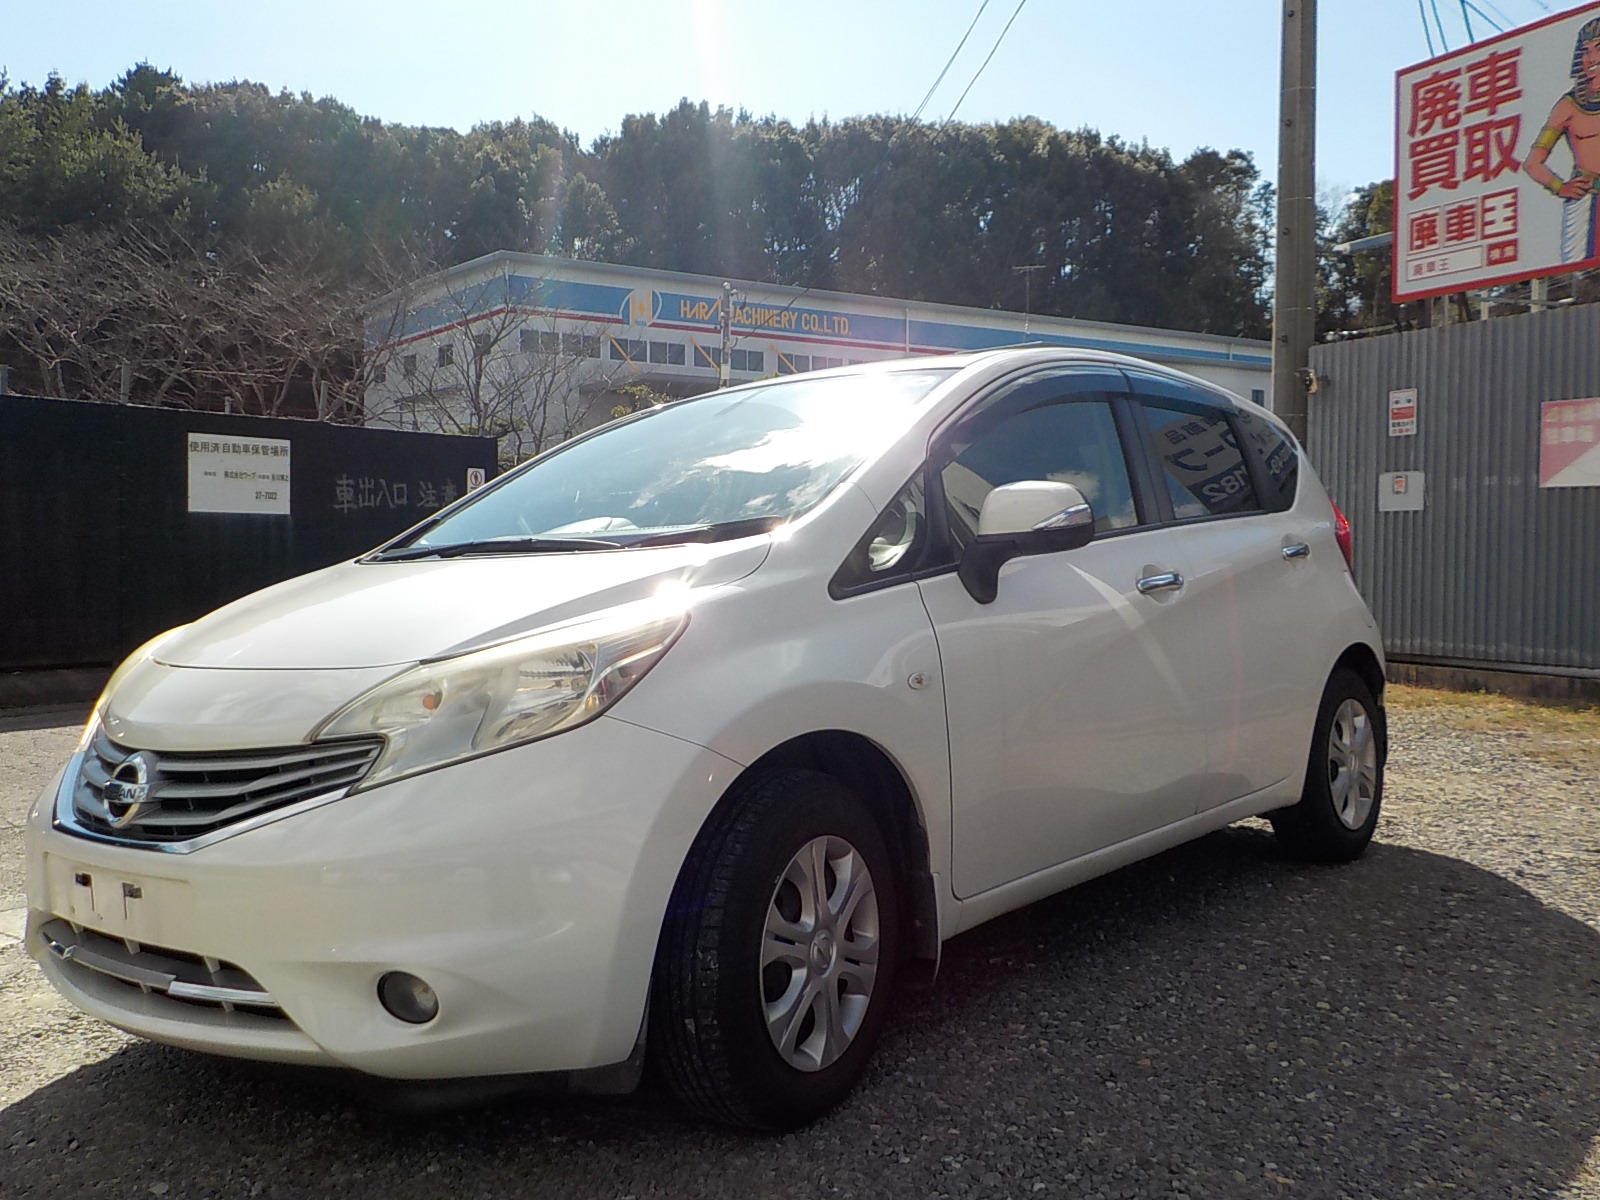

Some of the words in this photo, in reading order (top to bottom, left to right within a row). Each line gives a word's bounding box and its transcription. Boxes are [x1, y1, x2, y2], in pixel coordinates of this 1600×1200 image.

[1408, 46, 1523, 138] 廃車
[1407, 114, 1522, 201] 買取
[1409, 189, 1517, 251] 廃車王
[189, 440, 289, 457] 使用済自動車保管場所
[333, 474, 408, 513] 車出入口
